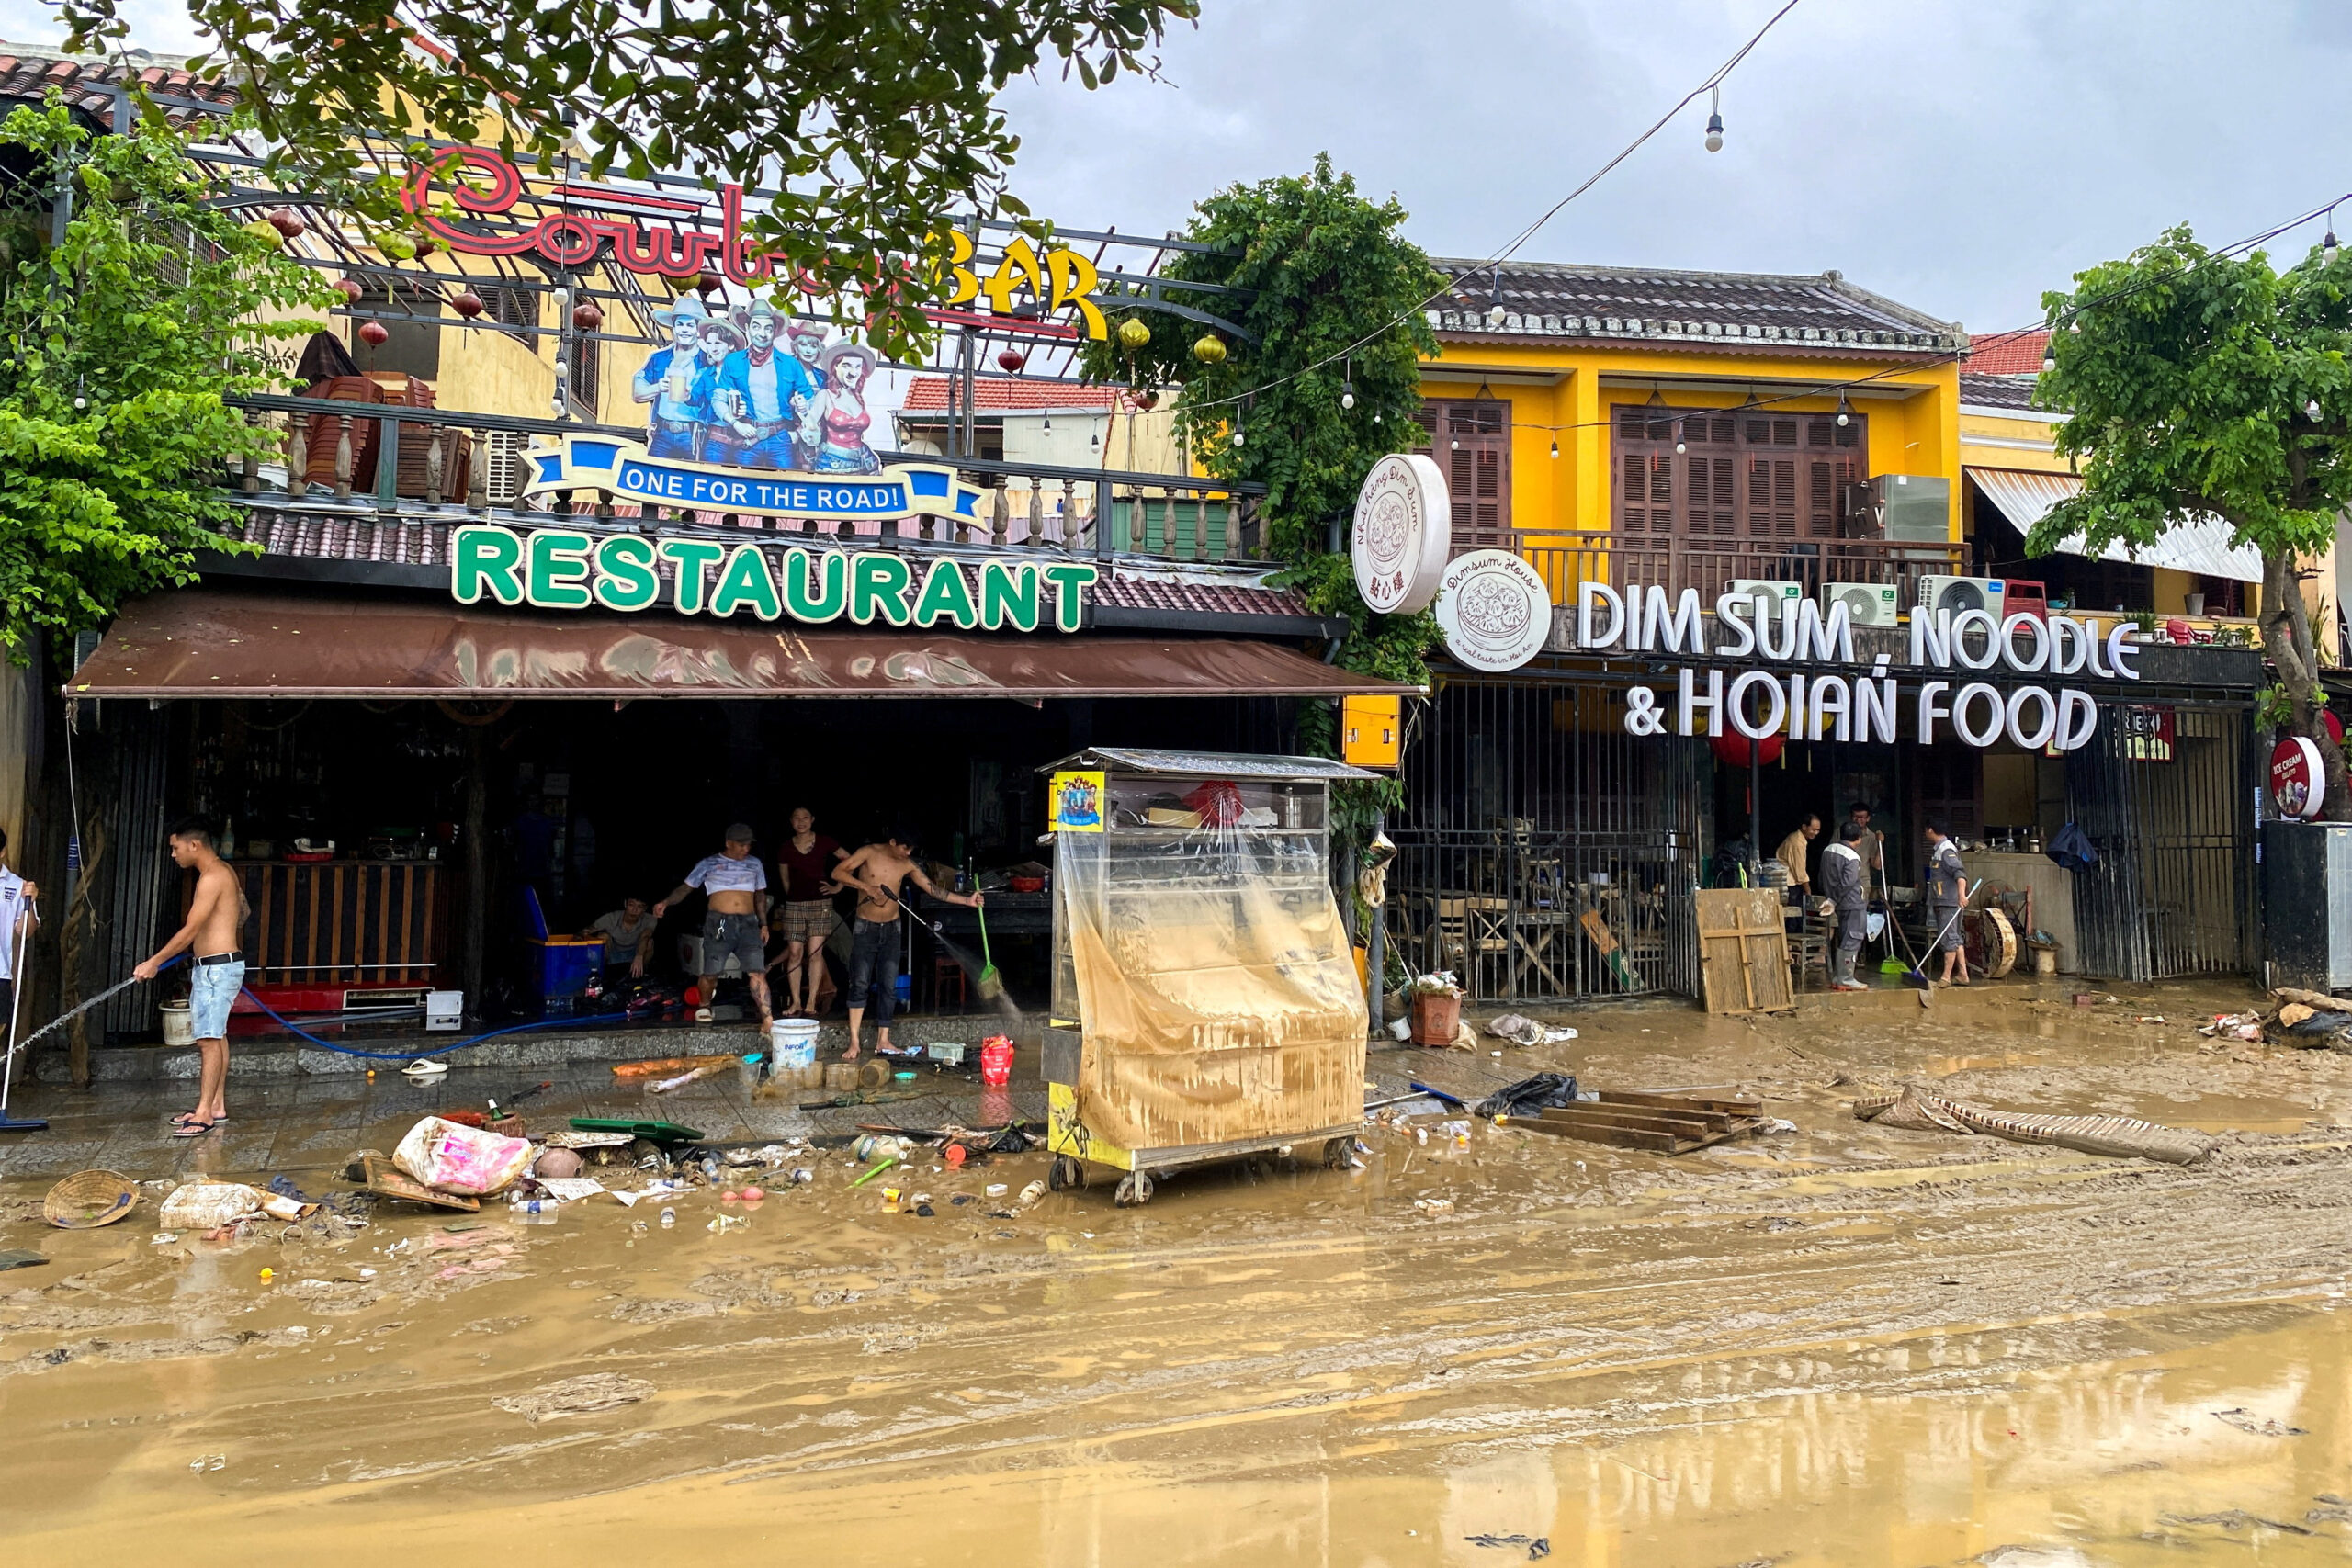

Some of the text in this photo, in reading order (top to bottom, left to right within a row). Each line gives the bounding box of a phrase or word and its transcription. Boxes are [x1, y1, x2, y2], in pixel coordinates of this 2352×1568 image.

[923, 228, 1108, 341] BAR
[625, 468, 899, 509] ONE FOR THE ROAD!
[1389, 465, 1408, 487] Dim
[1407, 486, 1418, 533] Sum
[450, 525, 1100, 634] RESTAURANT
[1446, 558, 1539, 594] Dimsum House
[1462, 645, 1477, 659] real
[1477, 653, 1498, 664] taste
[1522, 642, 1534, 653] An
[1577, 581, 1705, 655] DIM
[1910, 605, 2140, 681] NOODLE
[1623, 685, 1668, 737] &
[1919, 680, 2098, 751] FOOD
[2273, 753, 2301, 775] ICE CREAM
